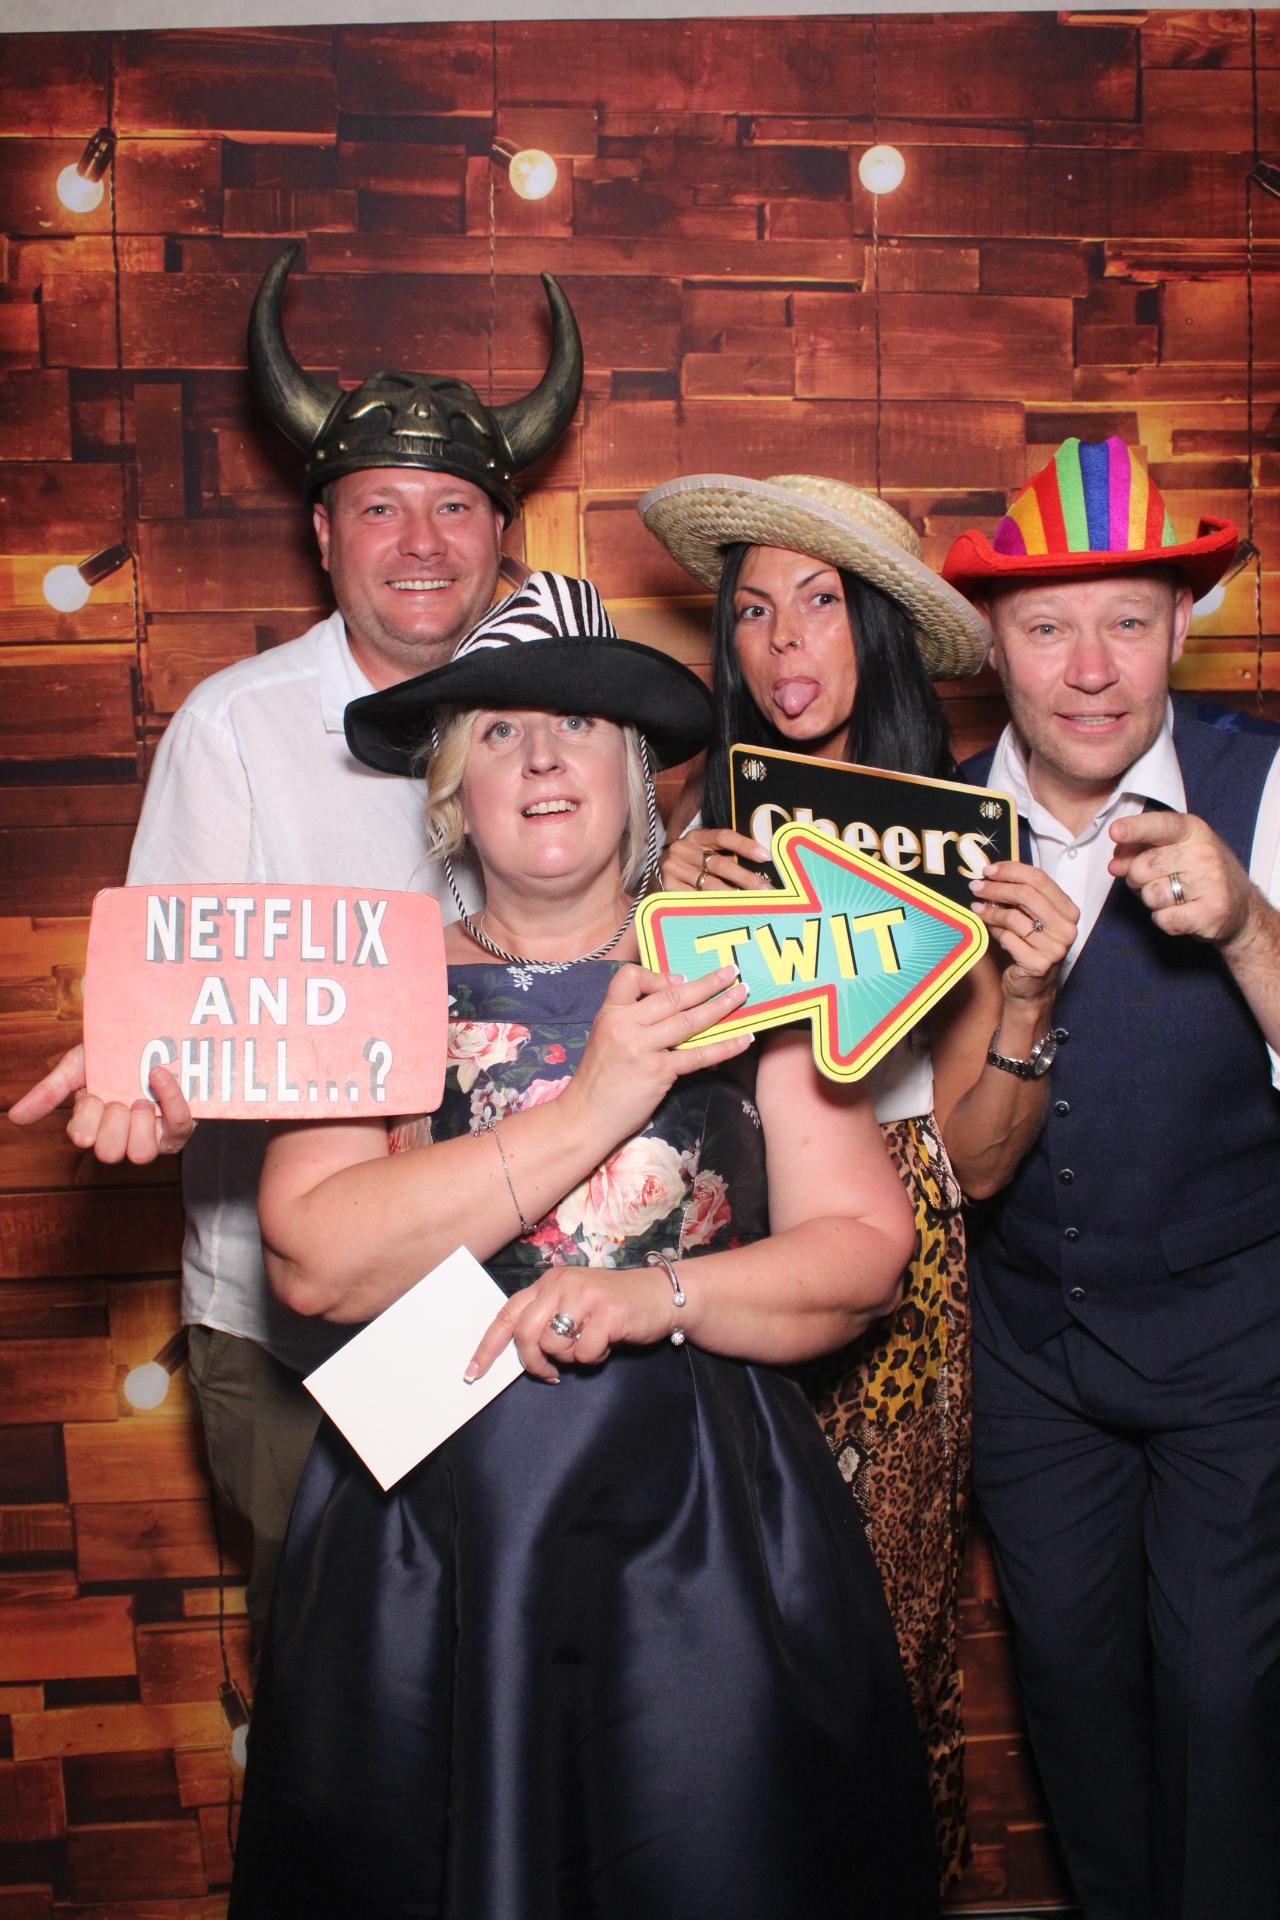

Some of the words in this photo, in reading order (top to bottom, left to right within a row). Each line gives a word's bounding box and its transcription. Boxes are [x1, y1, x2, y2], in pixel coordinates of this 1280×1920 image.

[145, 895, 390, 967] NETFLIX
[693, 906, 907, 986] TWIT
[189, 975, 349, 1026] AND
